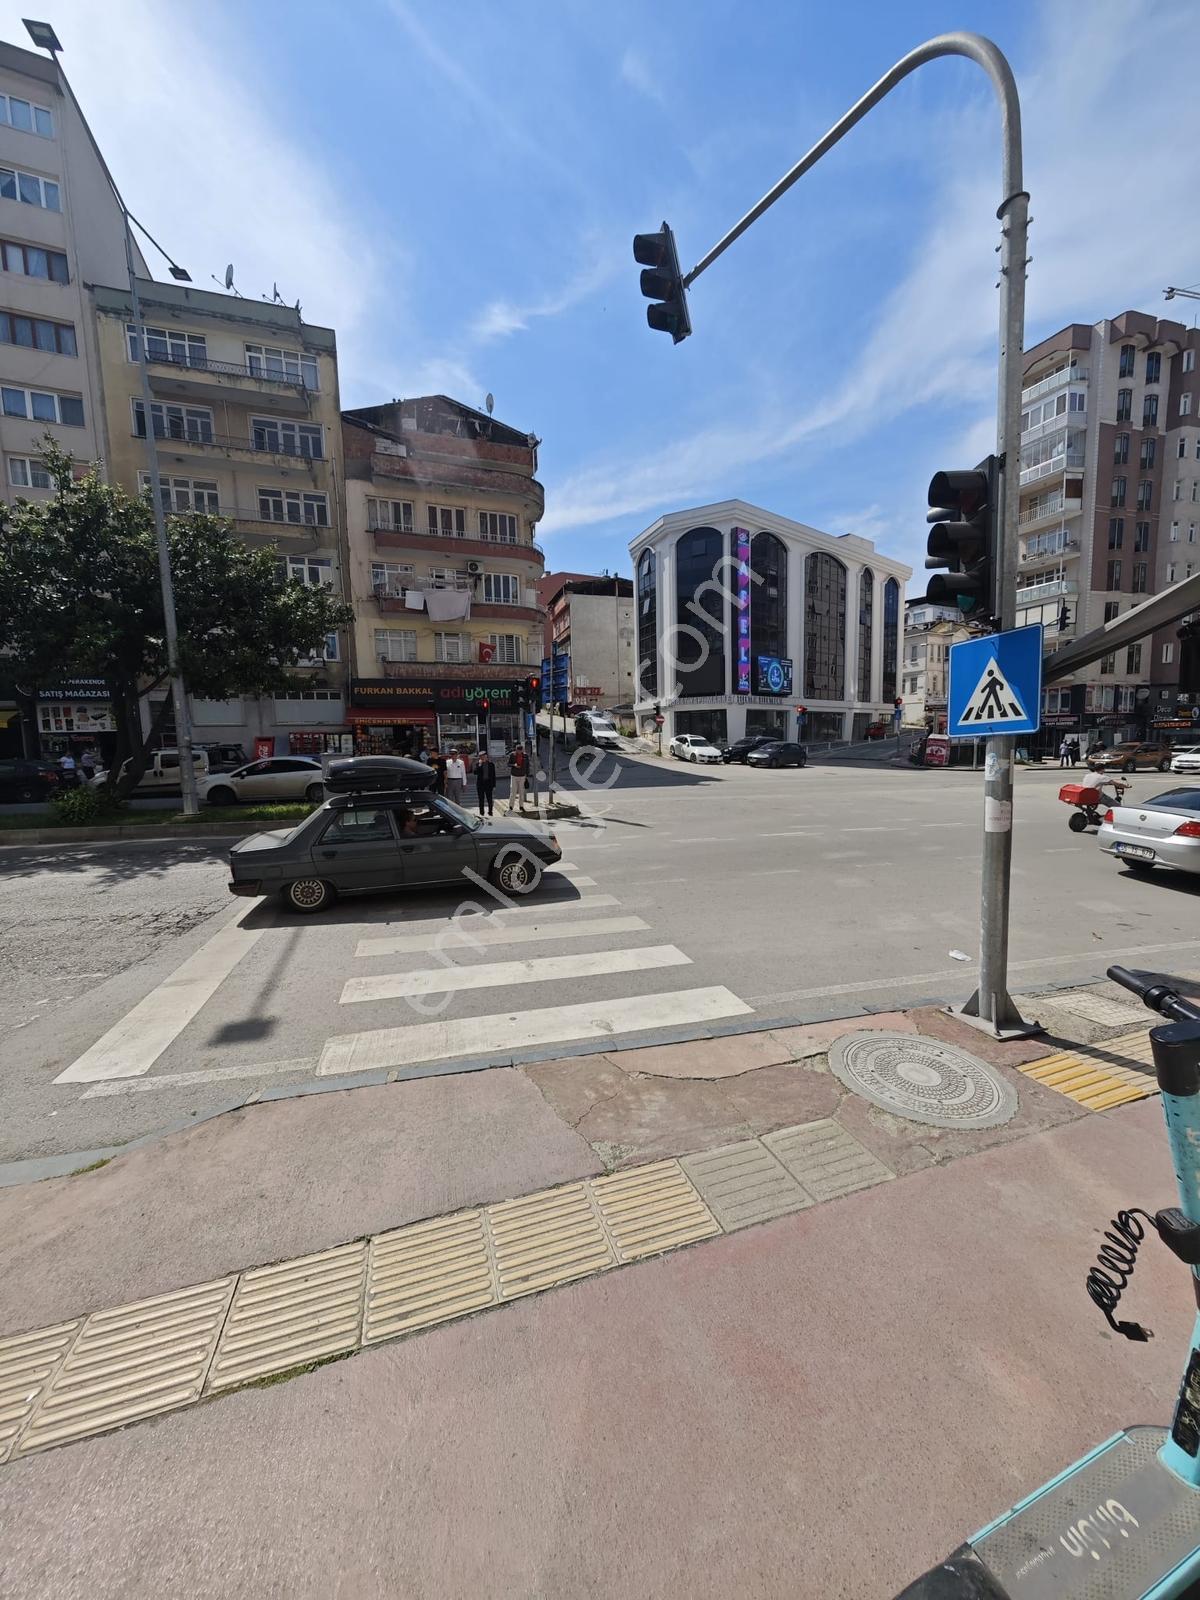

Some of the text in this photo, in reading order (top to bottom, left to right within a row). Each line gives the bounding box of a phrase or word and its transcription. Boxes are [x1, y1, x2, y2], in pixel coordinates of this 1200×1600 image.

[39, 688, 110, 698] SATIŞ MAĞAZASI
[353, 687, 433, 695] FURKAN BAKKAL
[1059, 1498, 1140, 1561] binbin
